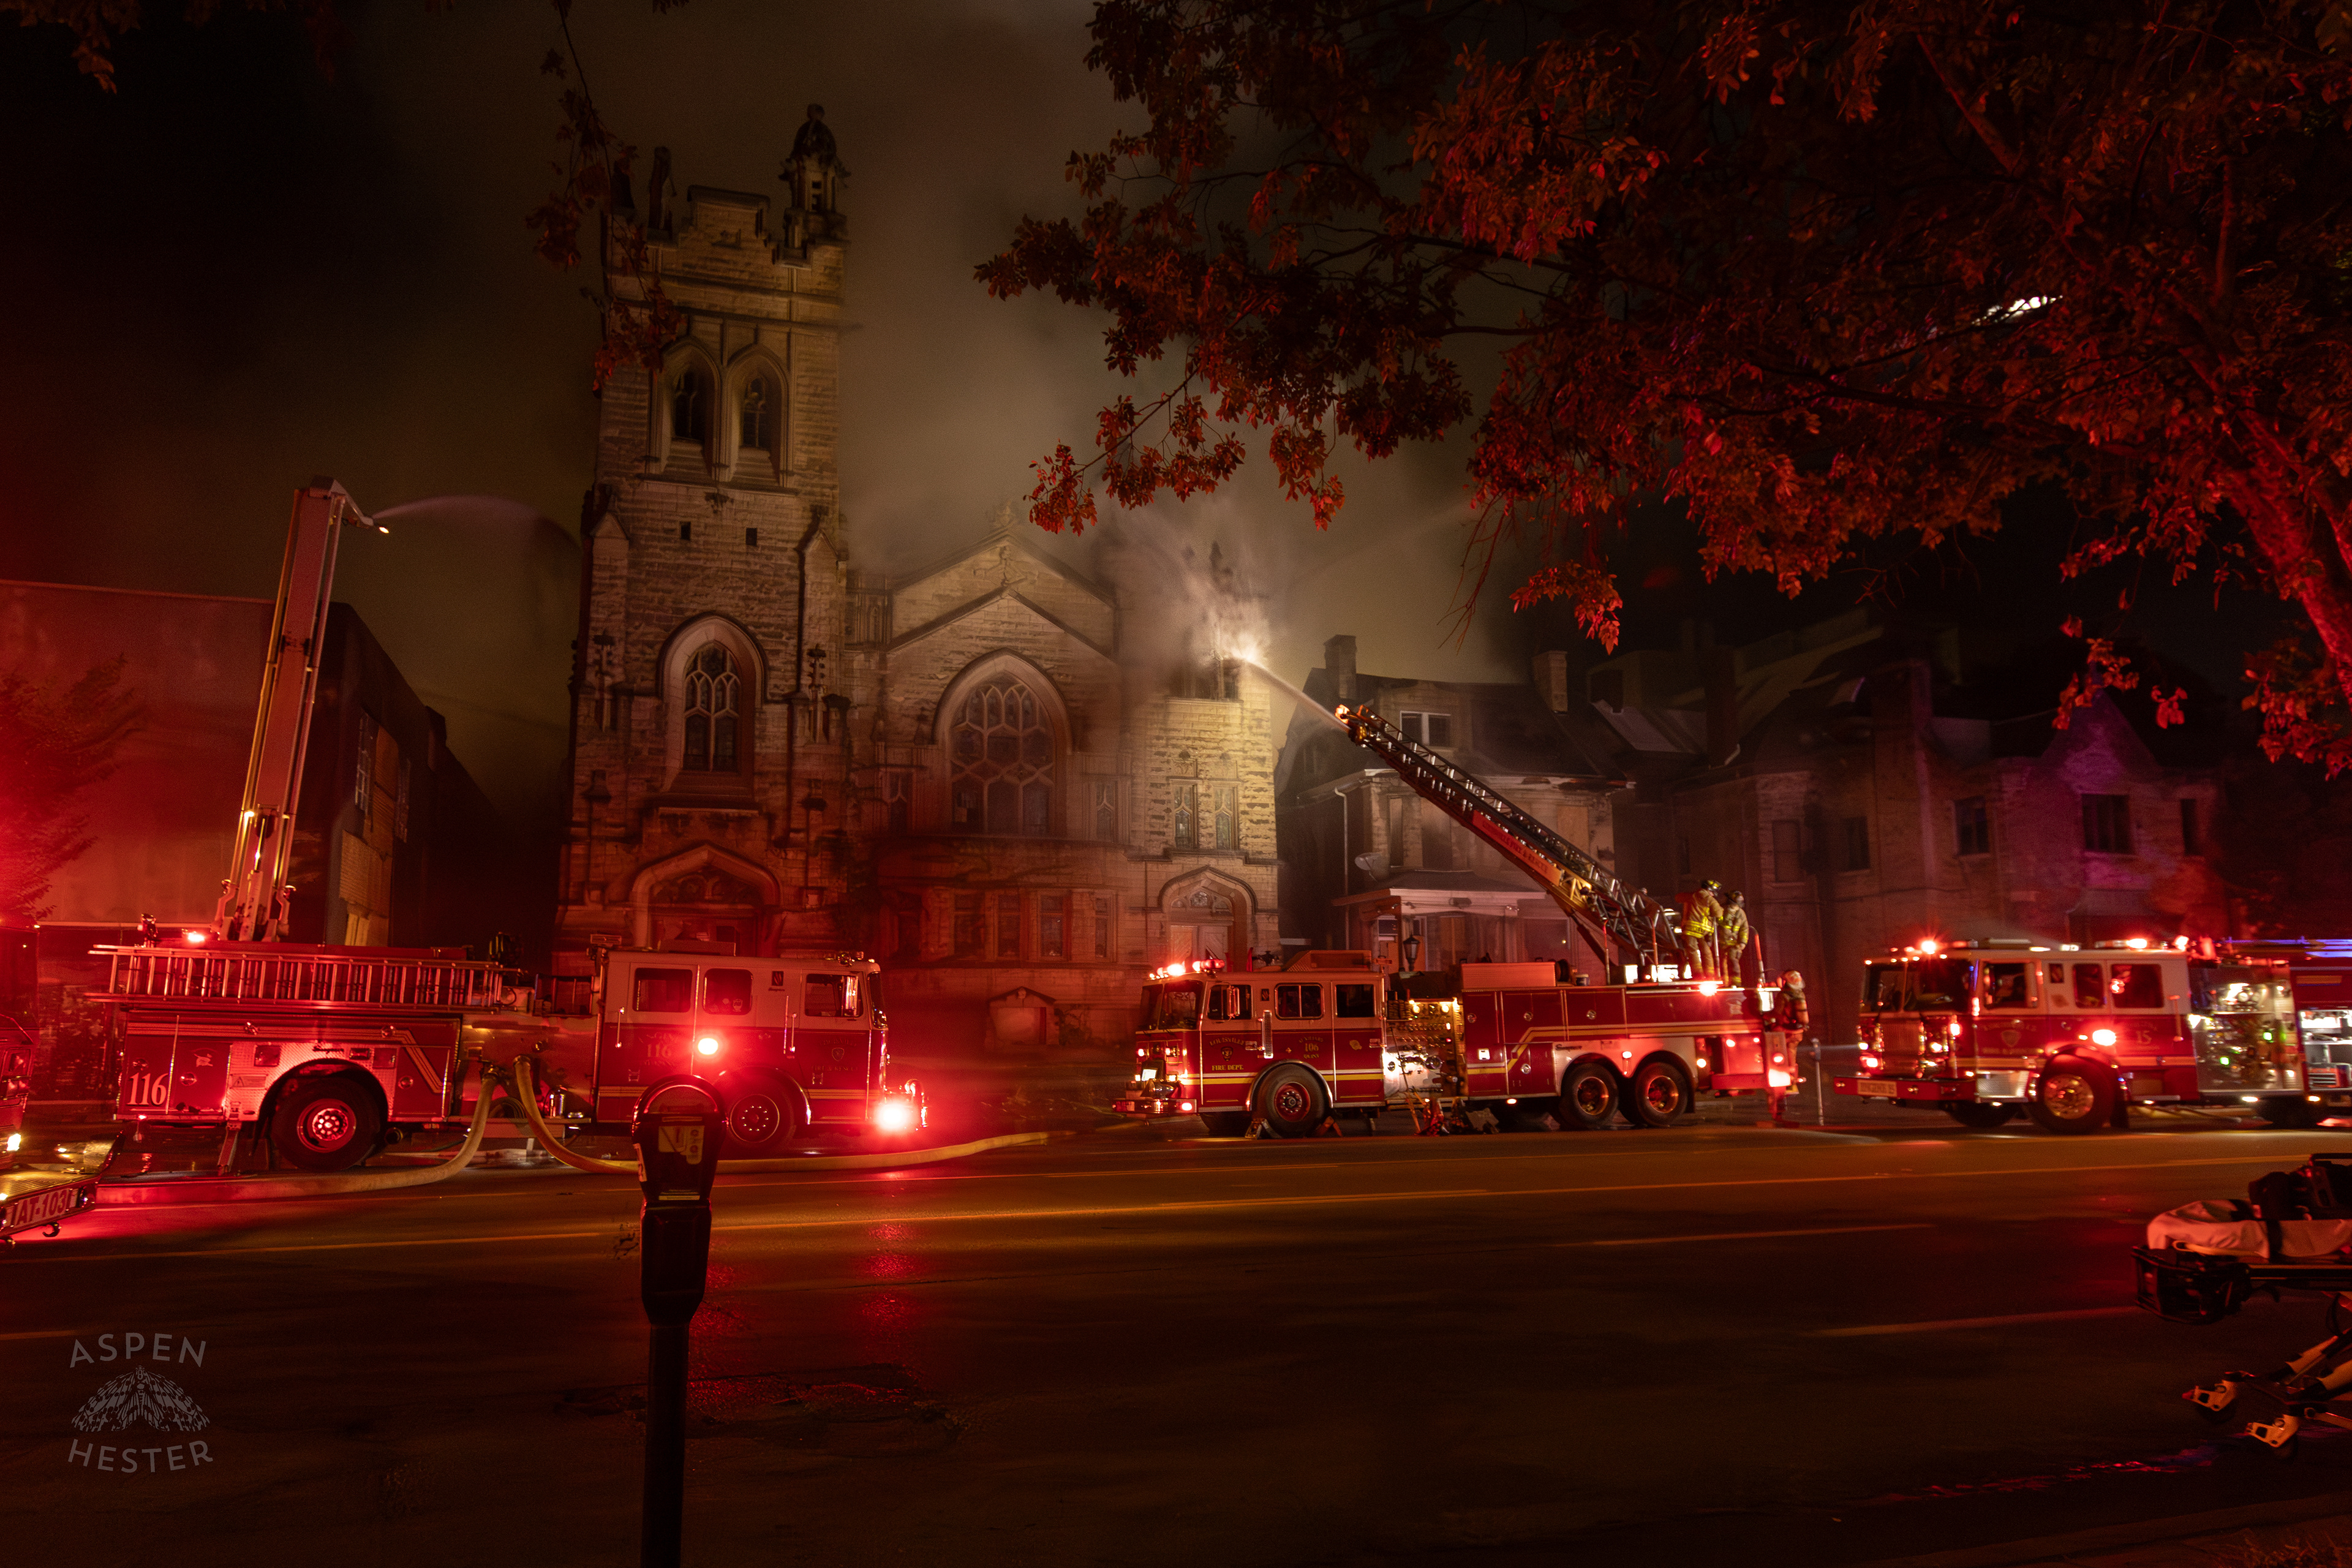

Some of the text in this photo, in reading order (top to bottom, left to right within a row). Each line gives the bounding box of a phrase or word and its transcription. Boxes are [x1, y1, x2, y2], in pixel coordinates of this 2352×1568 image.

[1209, 1037, 1245, 1046] LOUISVILLE
[1305, 1042, 1319, 1052] 106
[647, 1043, 672, 1058] 116
[127, 1073, 168, 1106] 116
